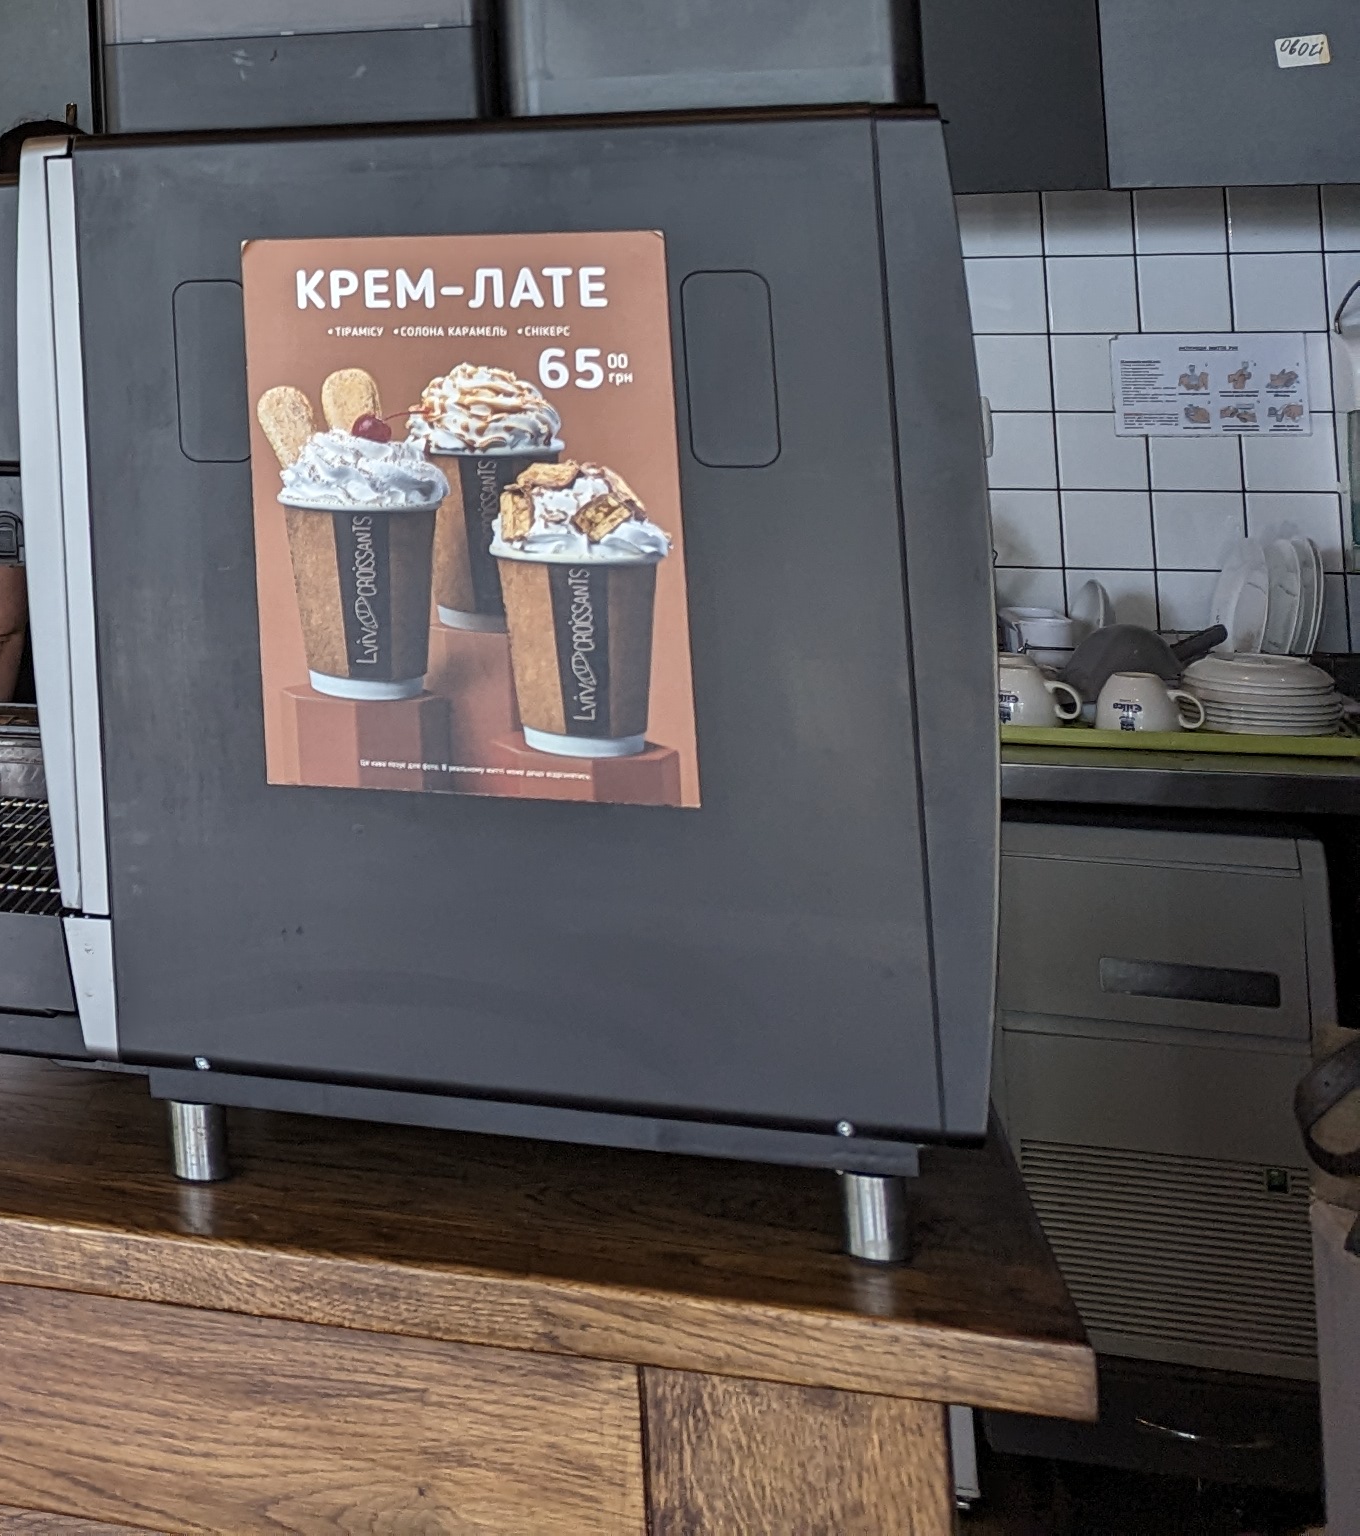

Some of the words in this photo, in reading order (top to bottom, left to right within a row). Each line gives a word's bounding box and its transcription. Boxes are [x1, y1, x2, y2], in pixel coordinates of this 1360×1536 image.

[295, 266, 609, 310] КРЕМ-ЛАТЕ
[538, 348, 604, 390] 65
[607, 353, 628, 369] 00
[608, 372, 633, 386] грн
